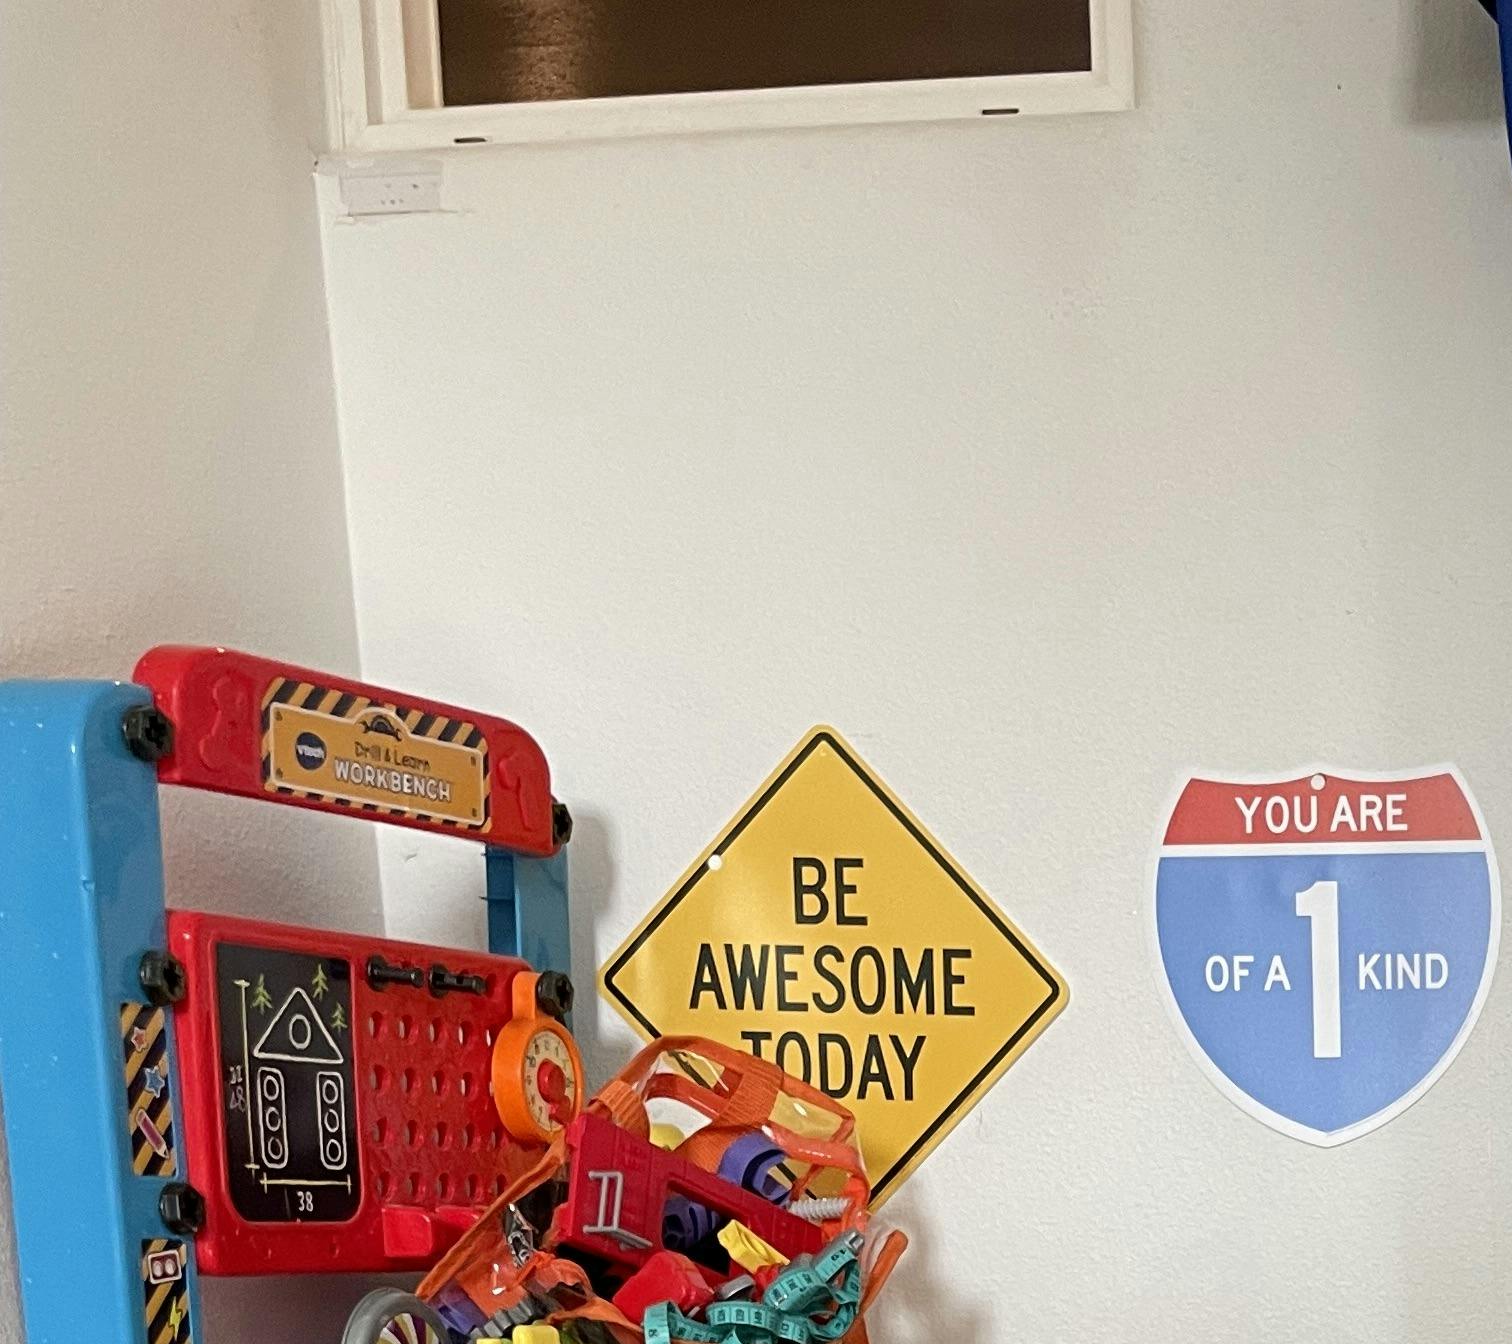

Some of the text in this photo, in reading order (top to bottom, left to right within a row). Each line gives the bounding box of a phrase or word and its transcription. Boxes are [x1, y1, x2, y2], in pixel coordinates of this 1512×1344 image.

[334, 758, 451, 802] WORKBENCH
[394, 745, 431, 772] Learn
[1234, 794, 1409, 834] YOU ARE
[792, 857, 868, 926] BE
[689, 943, 976, 1016] AWESOME
[1204, 880, 1449, 1059] OF A 1 KIND
[740, 1031, 927, 1102] TODAY
[296, 1190, 314, 1212] 38
